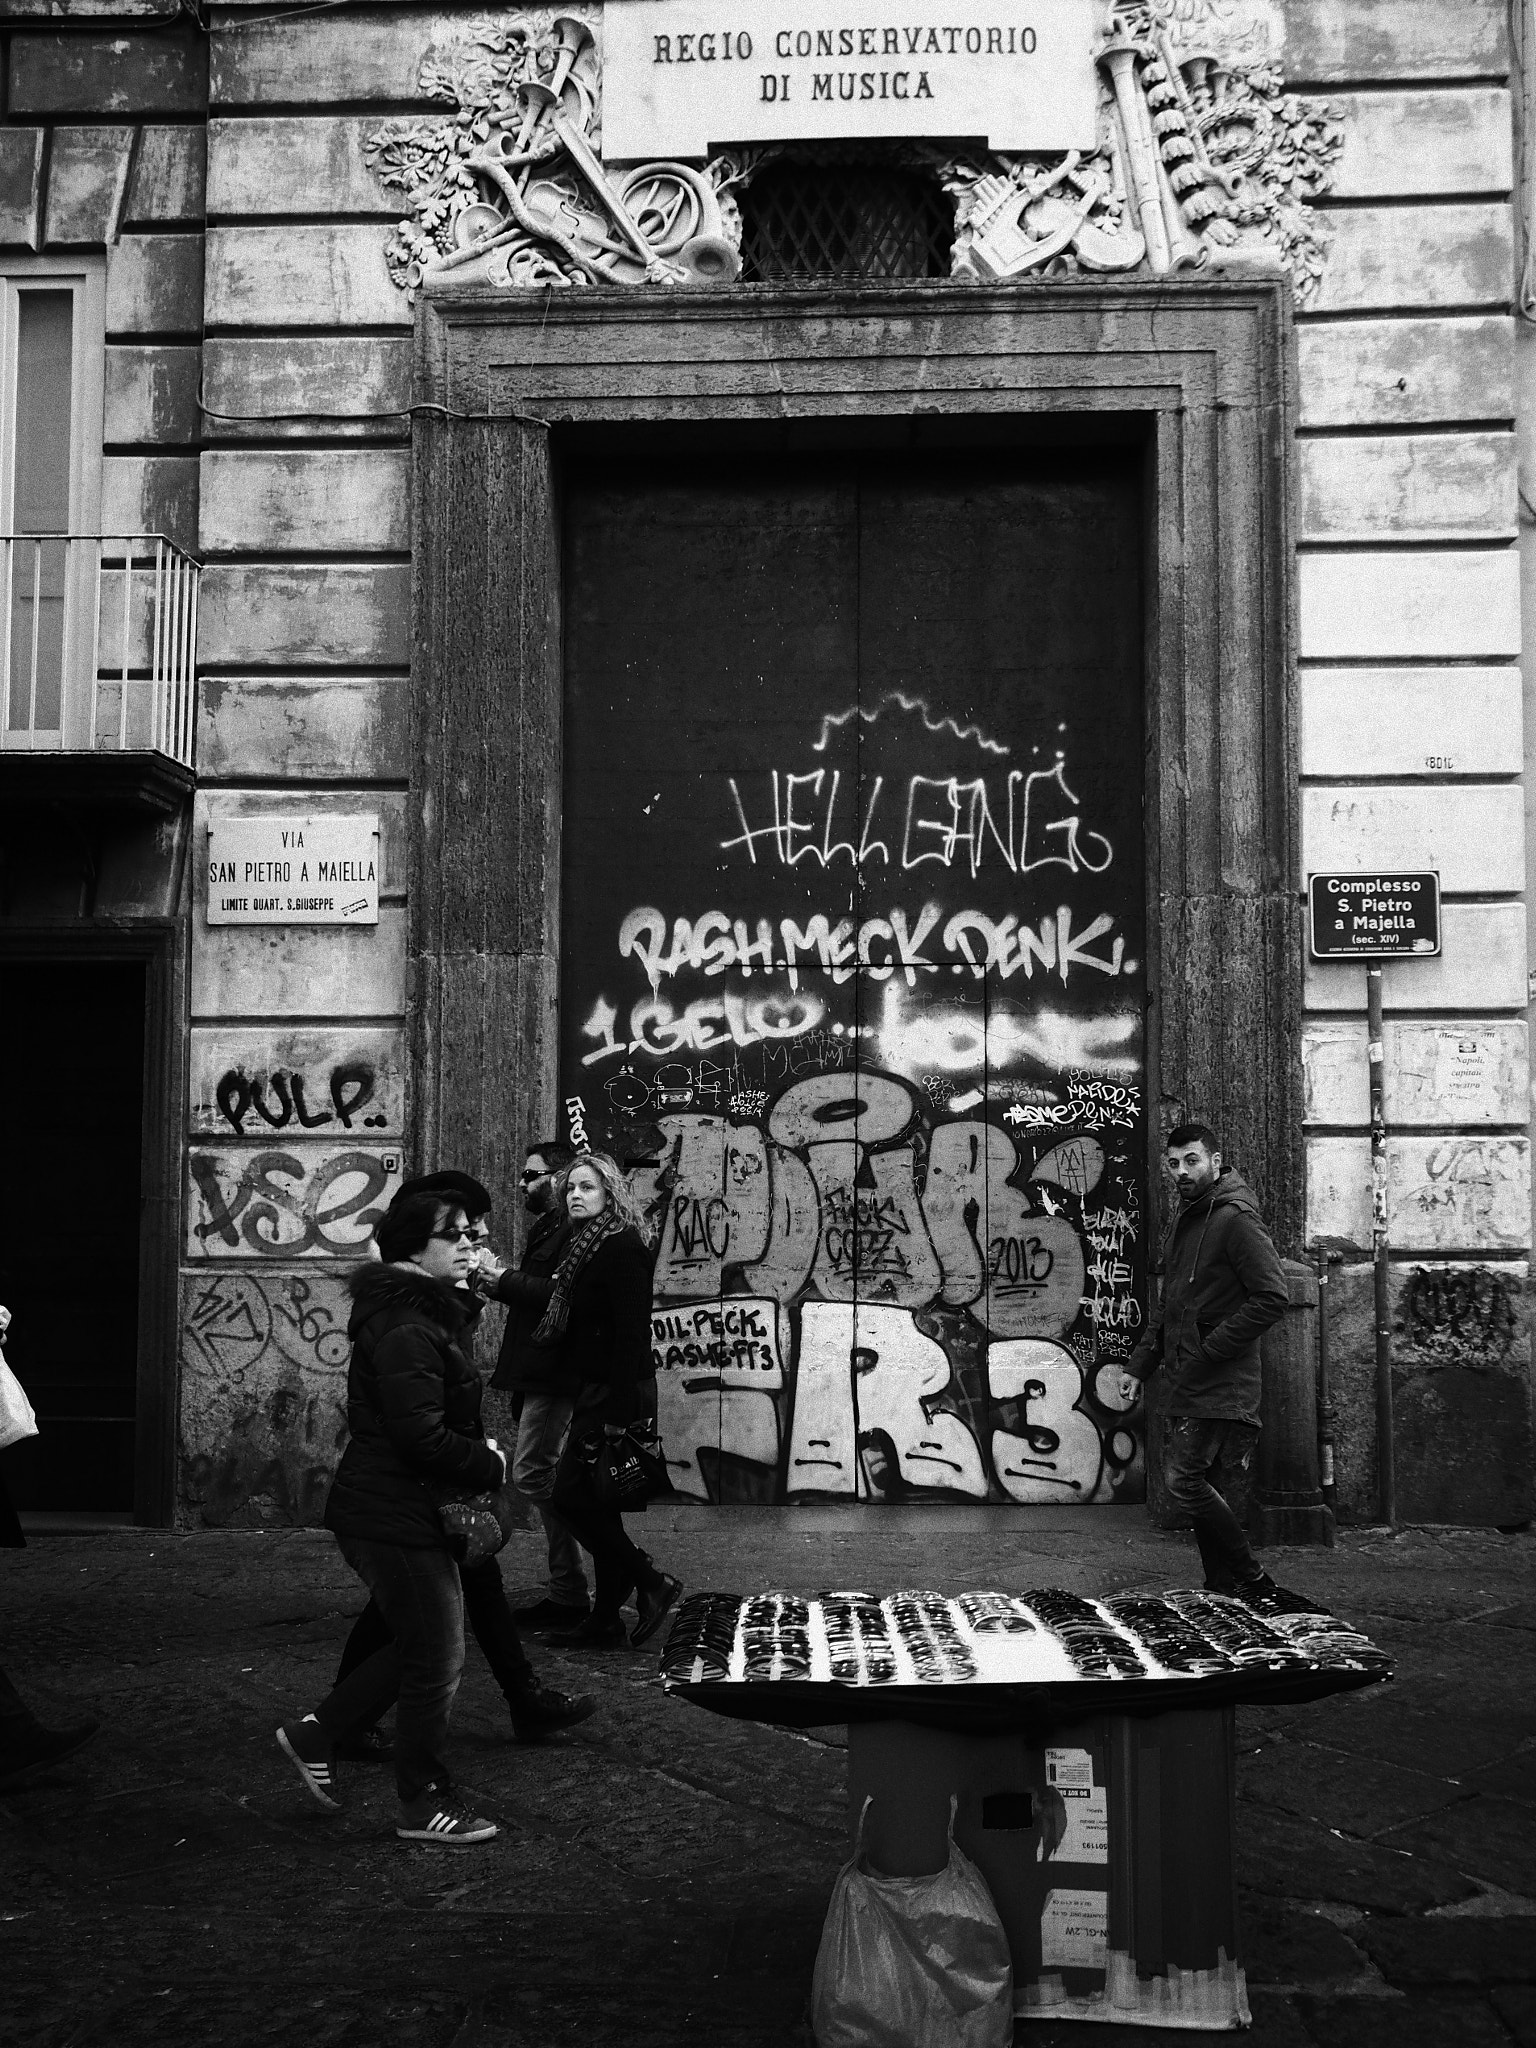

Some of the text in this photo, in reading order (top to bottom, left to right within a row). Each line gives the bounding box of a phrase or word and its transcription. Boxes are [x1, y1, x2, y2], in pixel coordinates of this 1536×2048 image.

[653, 26, 1037, 63] REGIO CONSERVATORIO
[760, 71, 934, 102] DI MUSICA
[281, 831, 304, 848] VIA
[209, 860, 376, 883] SAN PIETRO A MAIELLA
[1327, 878, 1421, 895] Complesso
[221, 898, 249, 911] LIMITE
[253, 898, 283, 911] QUART.
[287, 898, 334, 911] S.GIUSEPPE
[1337, 897, 1413, 912] S. Pietro
[1334, 914, 1416, 931] a Majella
[1352, 933, 1400, 945] (sec. XIV)
[988, 1236, 1053, 1284] 2013
